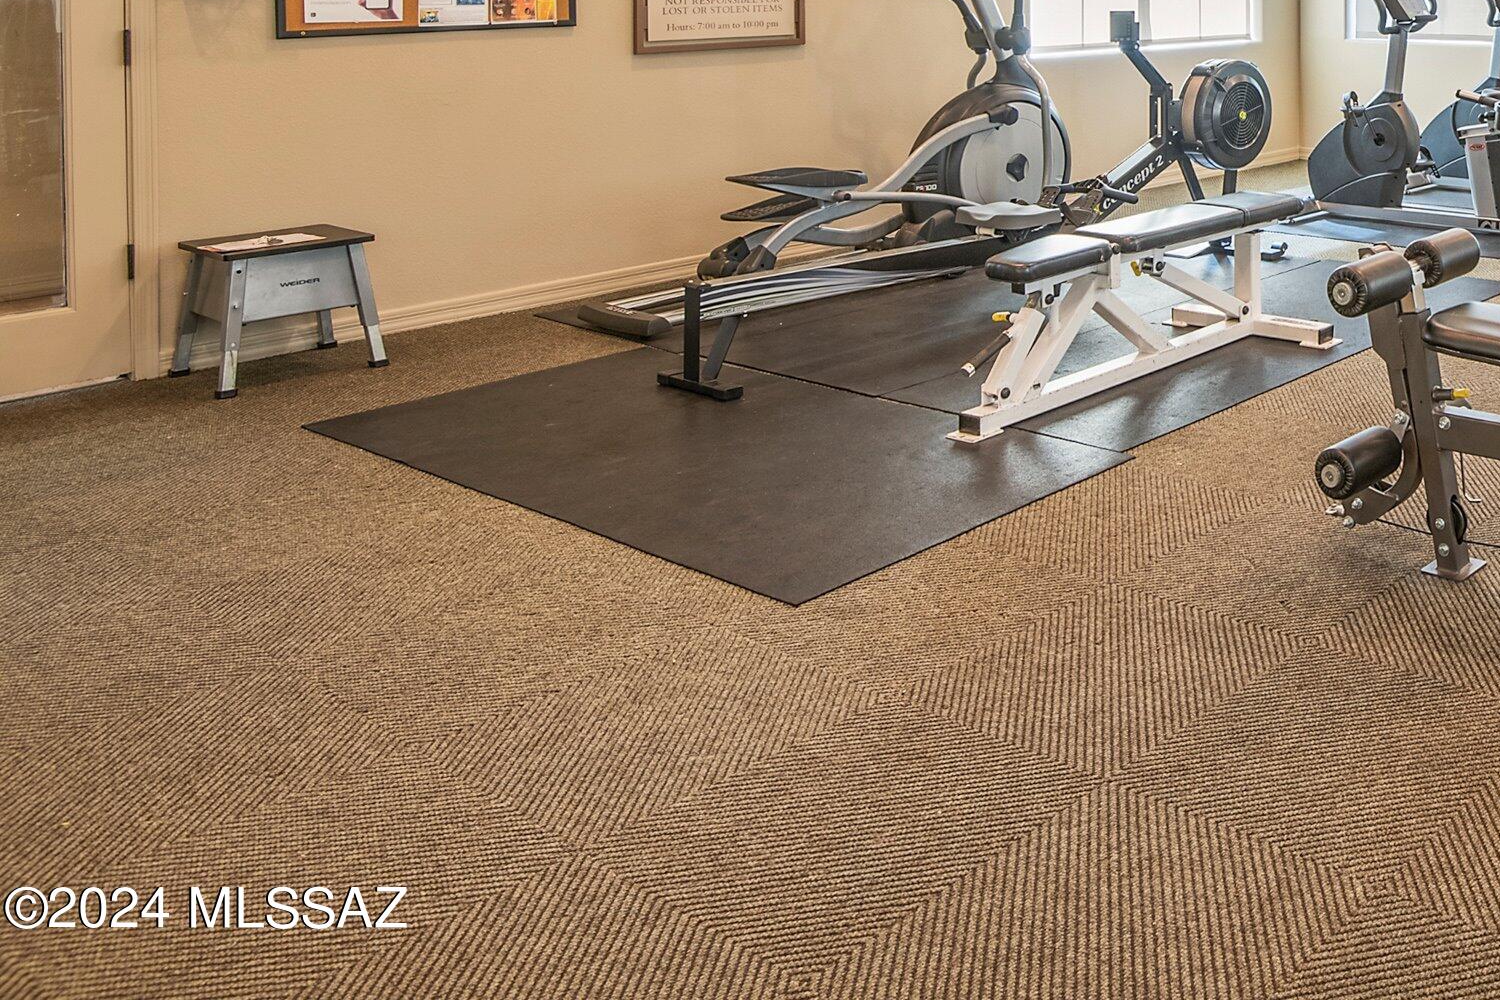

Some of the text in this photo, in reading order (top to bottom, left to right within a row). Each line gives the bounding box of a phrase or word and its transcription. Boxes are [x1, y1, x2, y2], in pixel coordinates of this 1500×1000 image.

[662, 4, 783, 15] LOST OR STOLEN ITEMS
[666, 23, 695, 31] Hours:
[698, 22, 716, 30] 7:00
[766, 21, 779, 30] pm
[1155, 154, 1165, 167] 2
